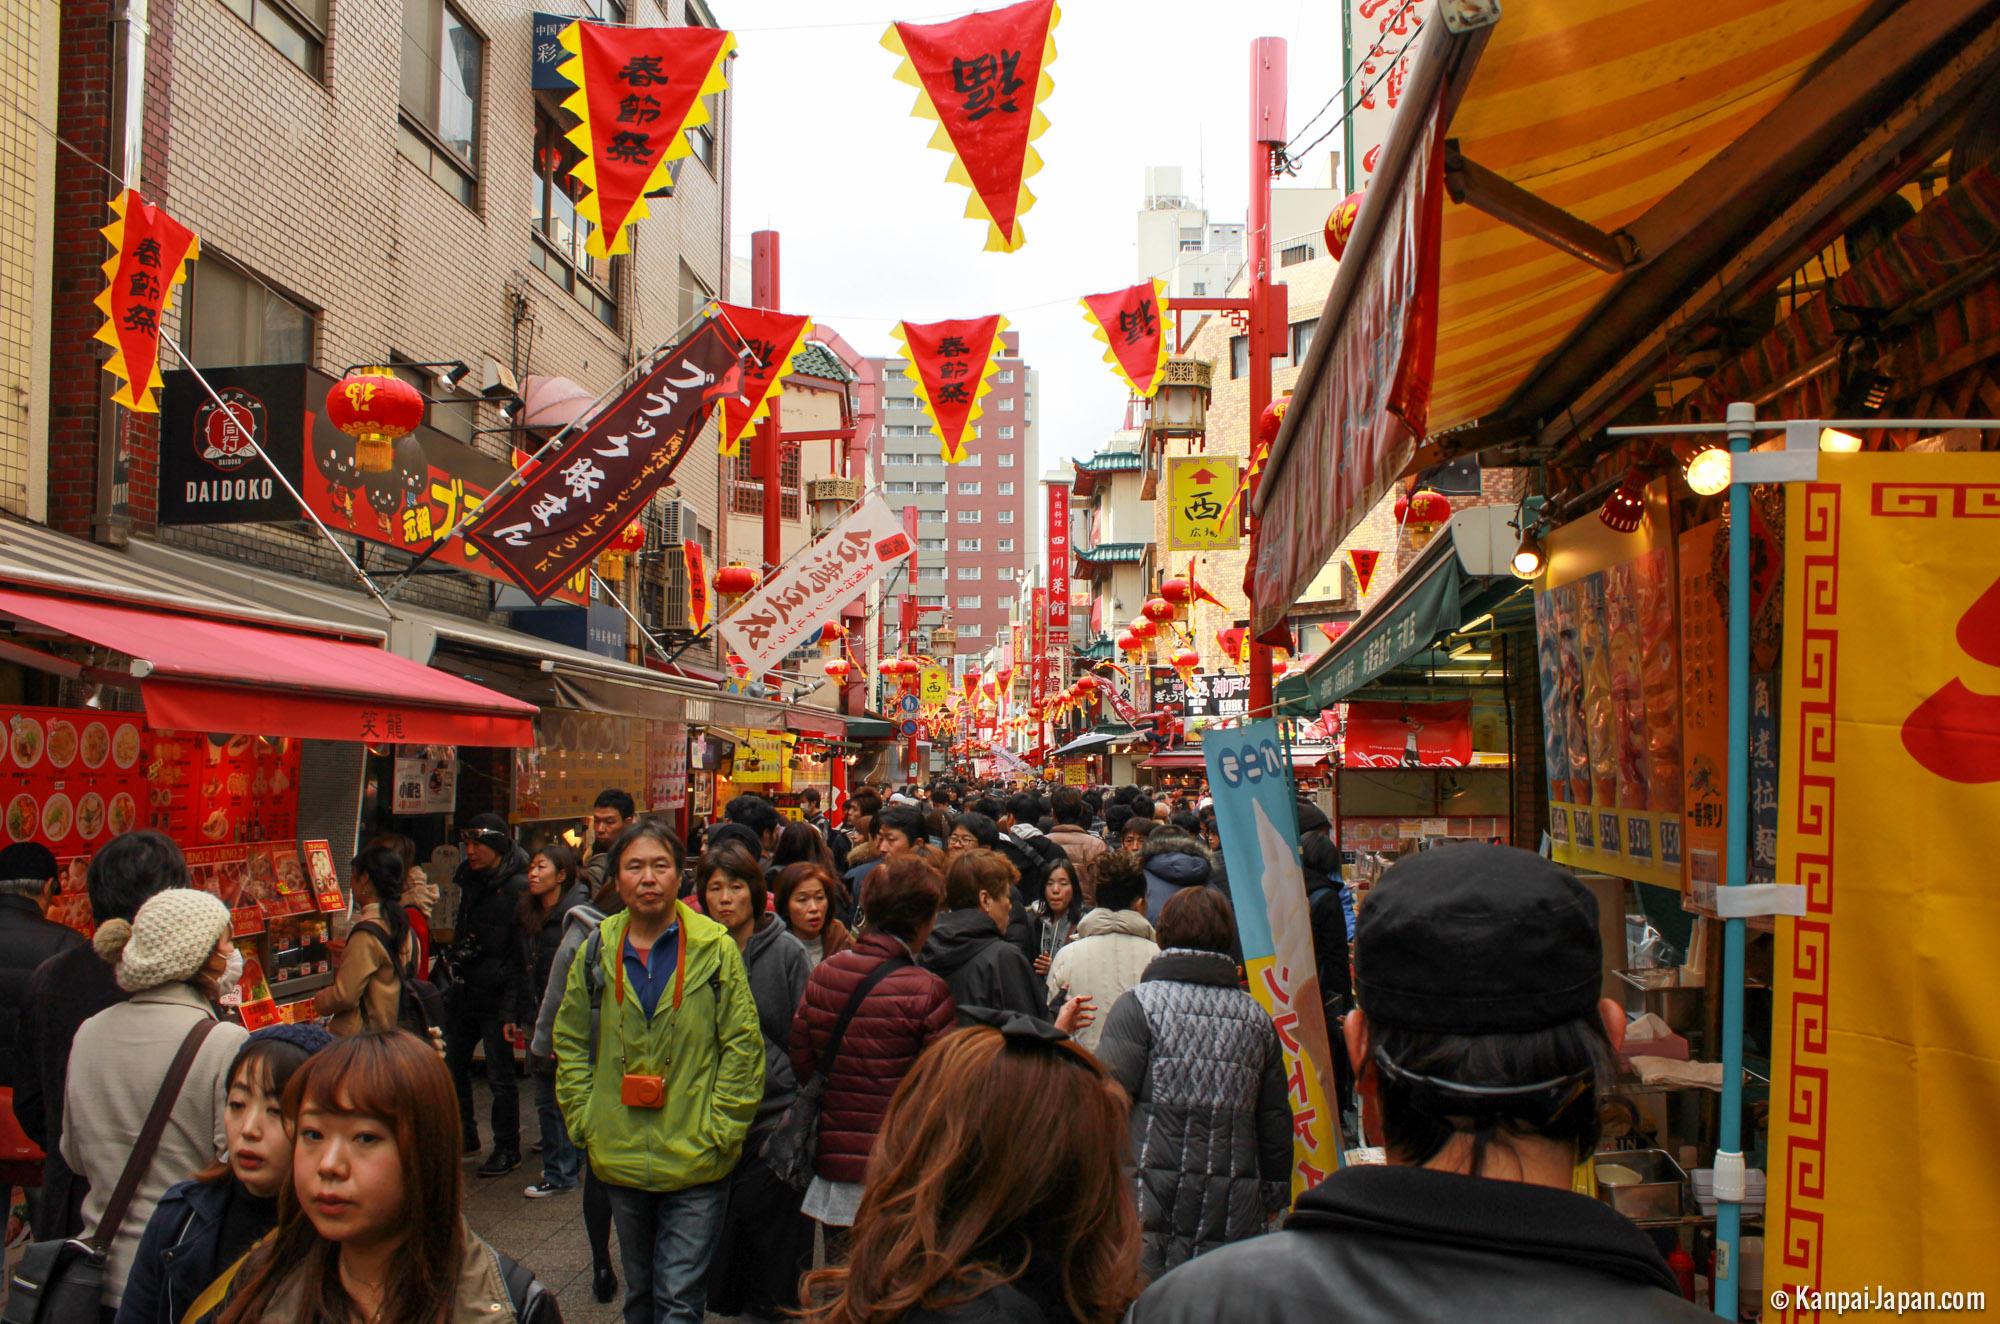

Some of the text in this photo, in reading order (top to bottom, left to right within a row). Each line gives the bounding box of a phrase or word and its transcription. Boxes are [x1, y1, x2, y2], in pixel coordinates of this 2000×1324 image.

[537, 43, 557, 64] 彩
[606, 55, 668, 165] 春節祭
[124, 236, 163, 338] 春節祭
[937, 335, 971, 405] 春節祭
[218, 458, 242, 466] DAIDOKO
[493, 358, 715, 548] ブラック豚まん
[186, 478, 273, 503] DAIDOKO
[1184, 491, 1222, 522] 西
[402, 506, 432, 544] 元祖
[733, 528, 873, 651] 台湾豆花
[1050, 535, 1067, 617] 四川菜館
[1219, 698, 1243, 712] KOBE
[360, 710, 406, 739] 笑龍
[1688, 801, 1723, 828] 一番搾り
